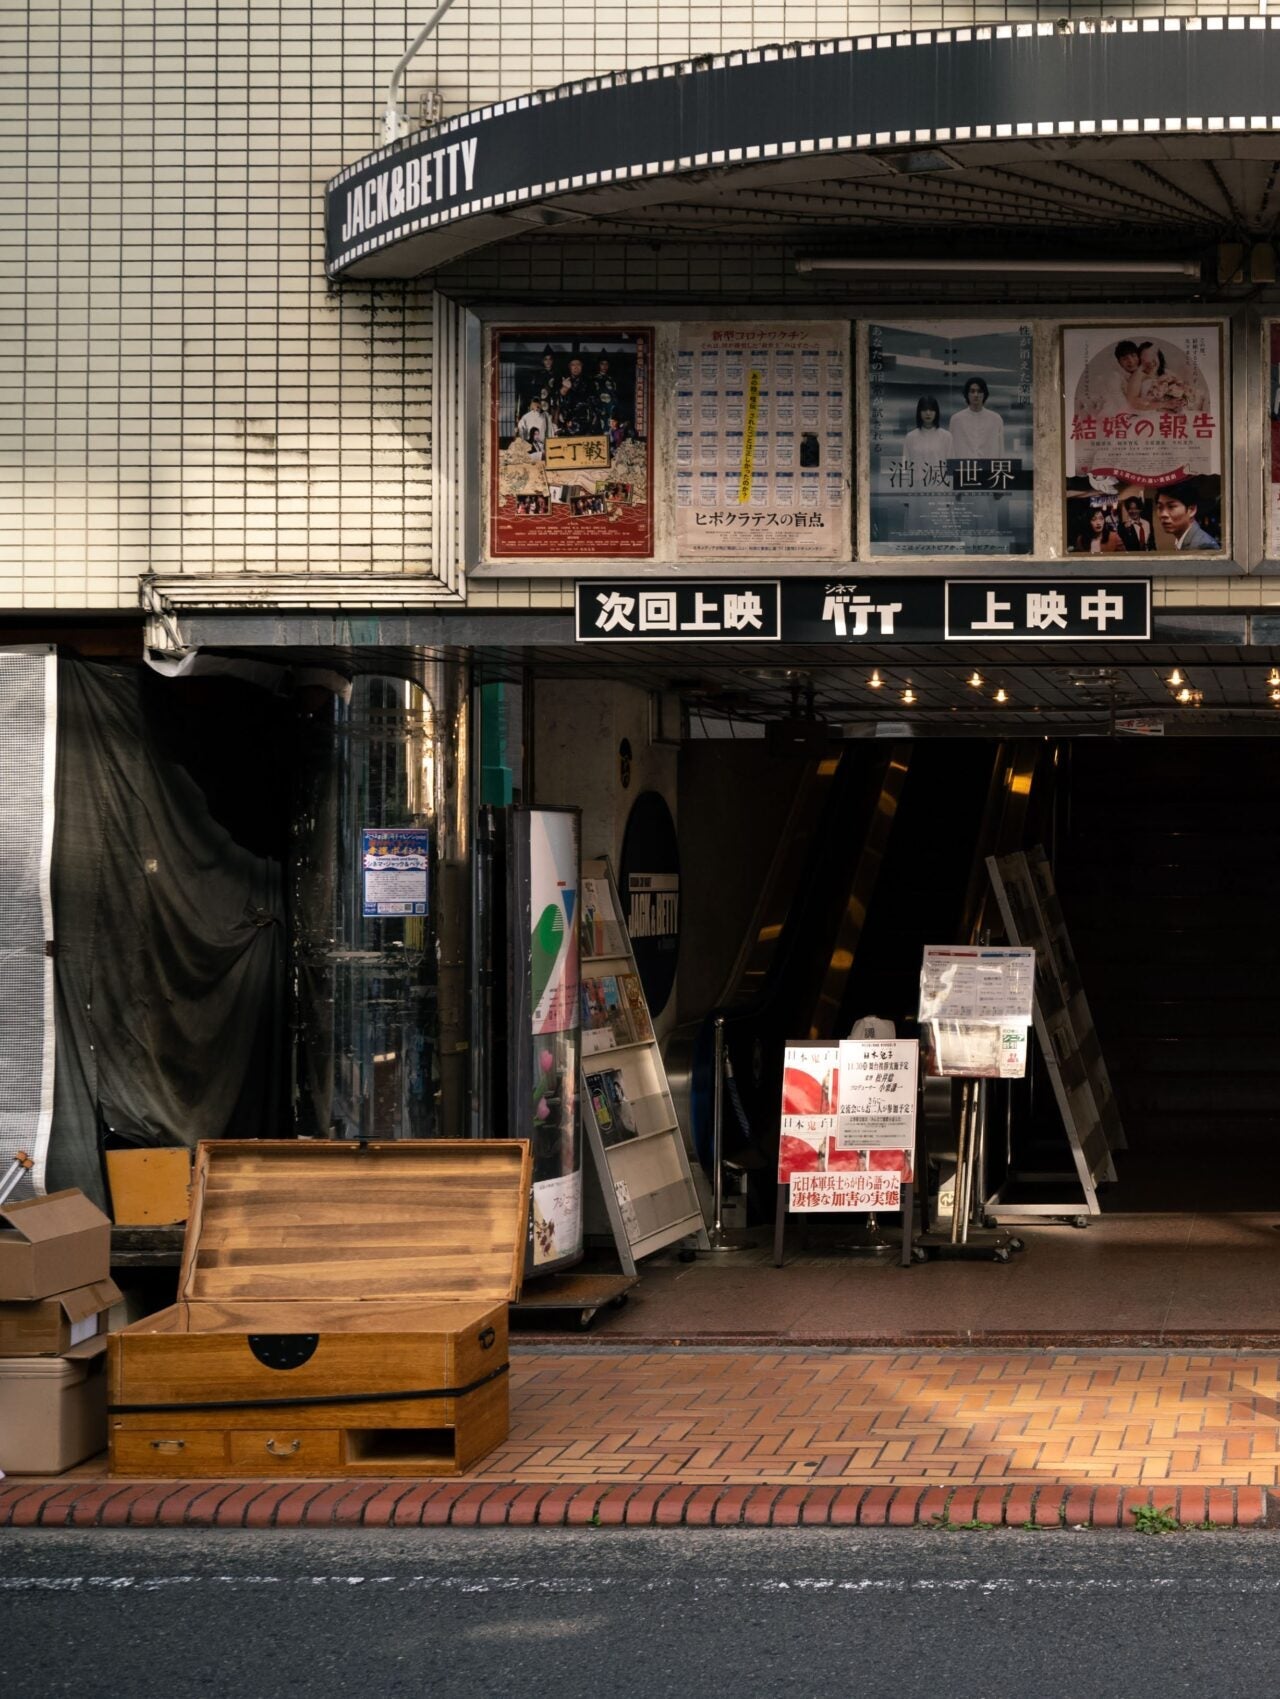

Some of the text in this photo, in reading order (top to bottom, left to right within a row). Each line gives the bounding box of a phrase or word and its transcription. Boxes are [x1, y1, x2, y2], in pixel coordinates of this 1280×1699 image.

[341, 137, 478, 242] JACK&BETTY
[712, 330, 809, 341] 新型コロナワクチン
[1070, 412, 1216, 440] 結婚の報告
[889, 460, 1015, 489] 消滅世界
[695, 511, 825, 528] ヒポクラテスの盲点
[824, 584, 856, 595] シネマ
[595, 591, 763, 631] 次回上映
[970, 590, 1124, 631] 上映中
[793, 1176, 899, 1190] 元日本軍兵士らが自ら語った
[792, 1190, 900, 1207] 凄惨な加害の実態
